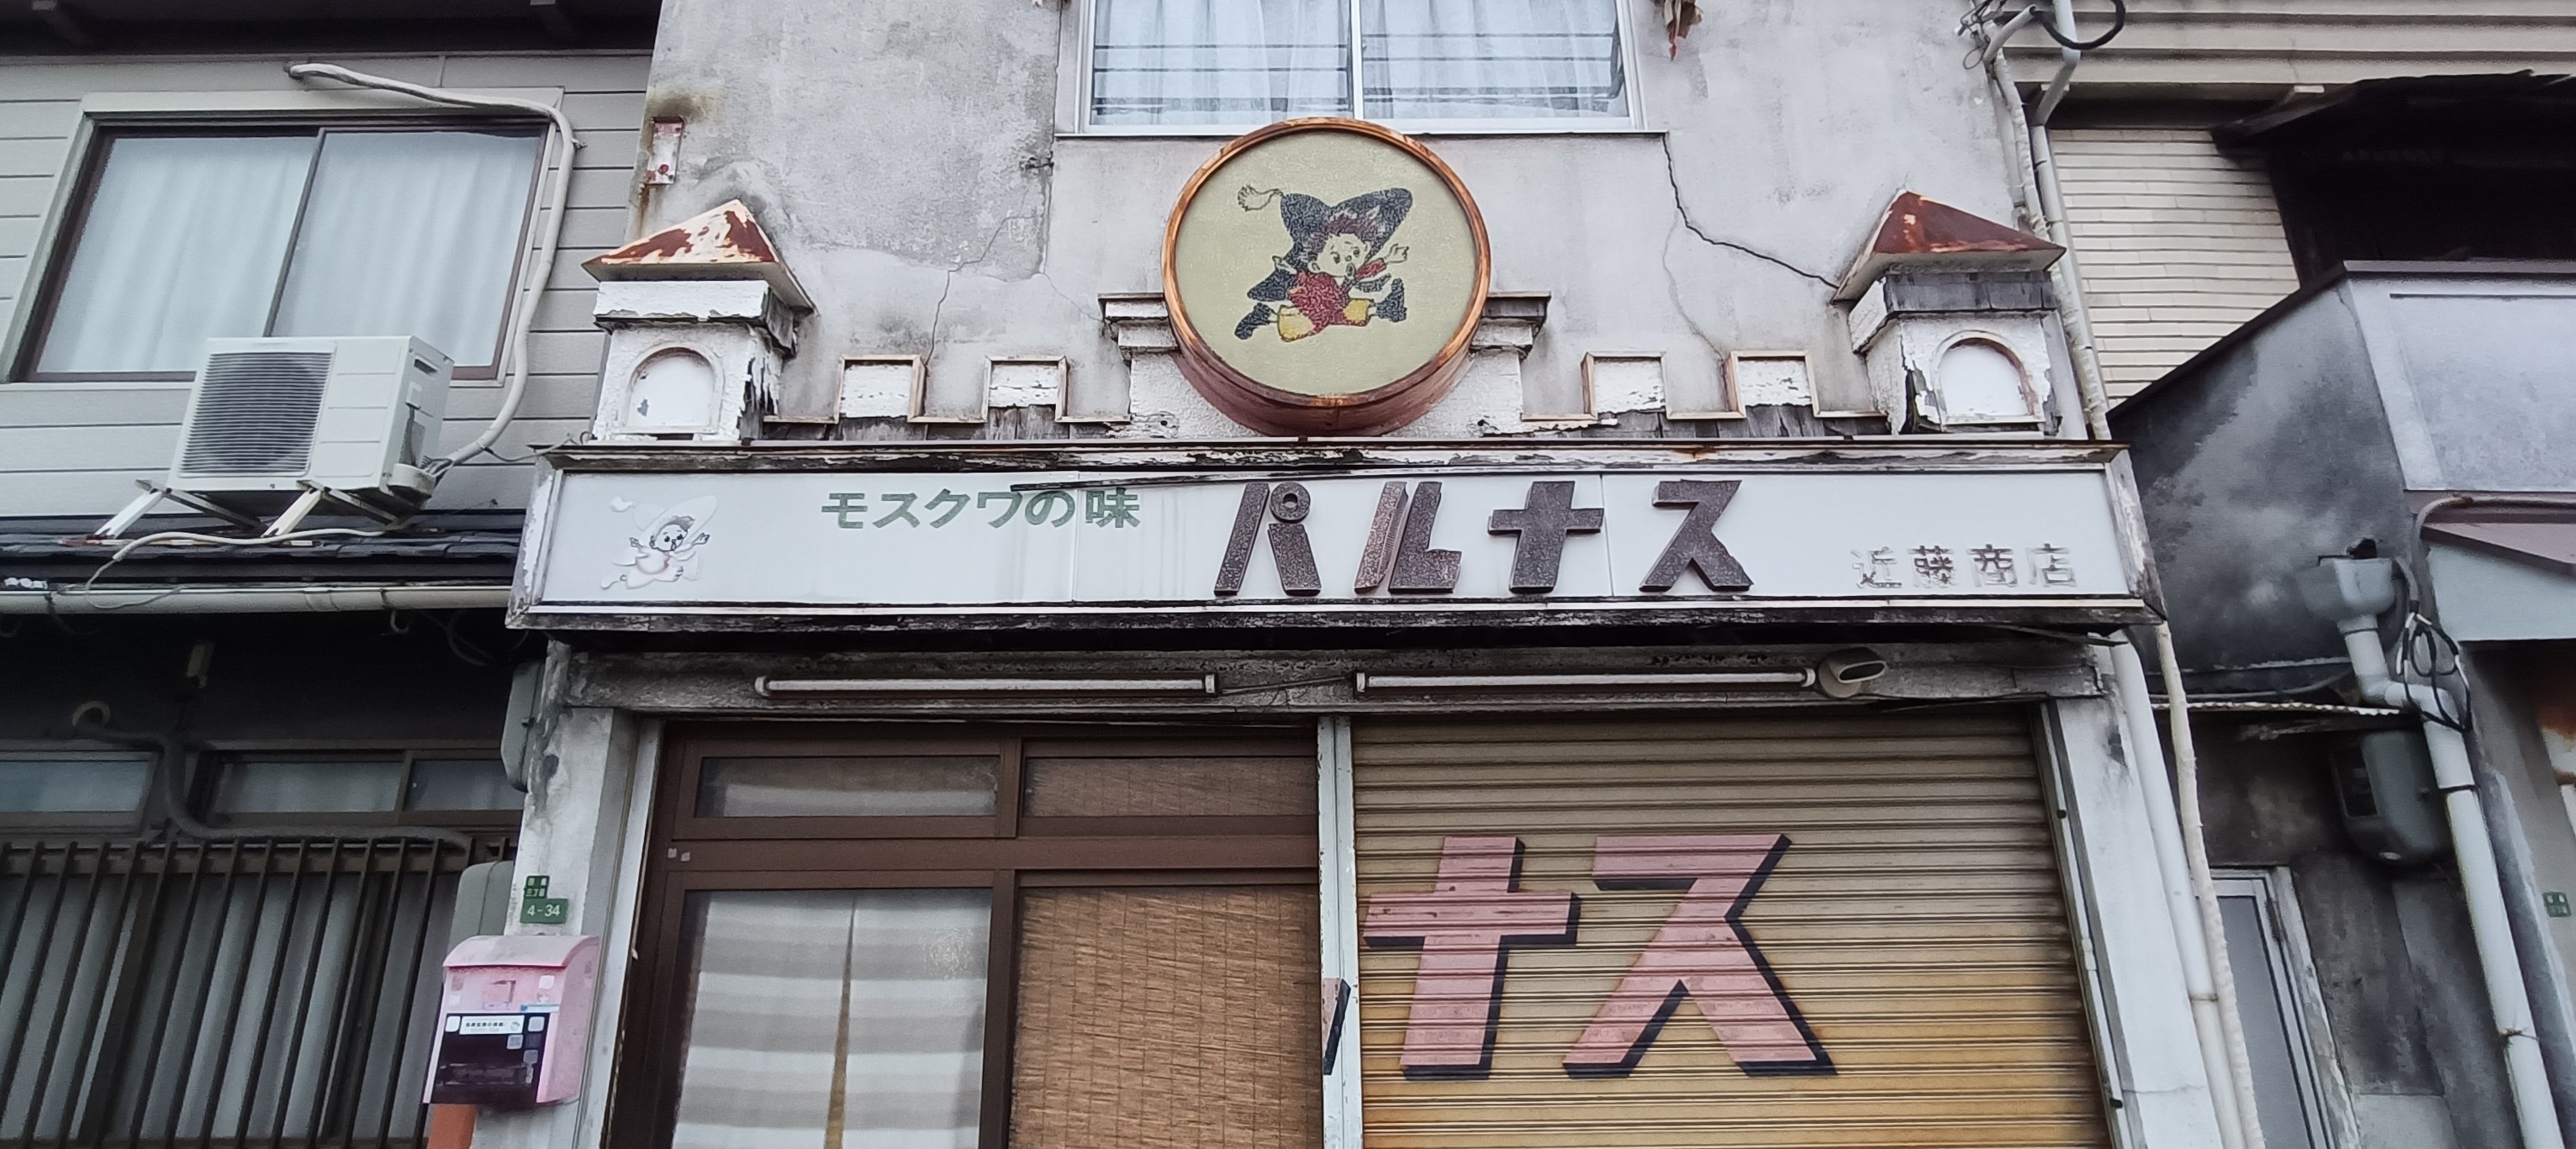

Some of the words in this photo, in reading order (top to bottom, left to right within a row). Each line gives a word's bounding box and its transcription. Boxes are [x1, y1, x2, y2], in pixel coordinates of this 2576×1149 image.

[821, 488, 1141, 530] モスクワの味
[1214, 478, 1754, 596] パルナス
[1850, 544, 2077, 588] 近藤商店
[526, 904, 561, 917] 4-34
